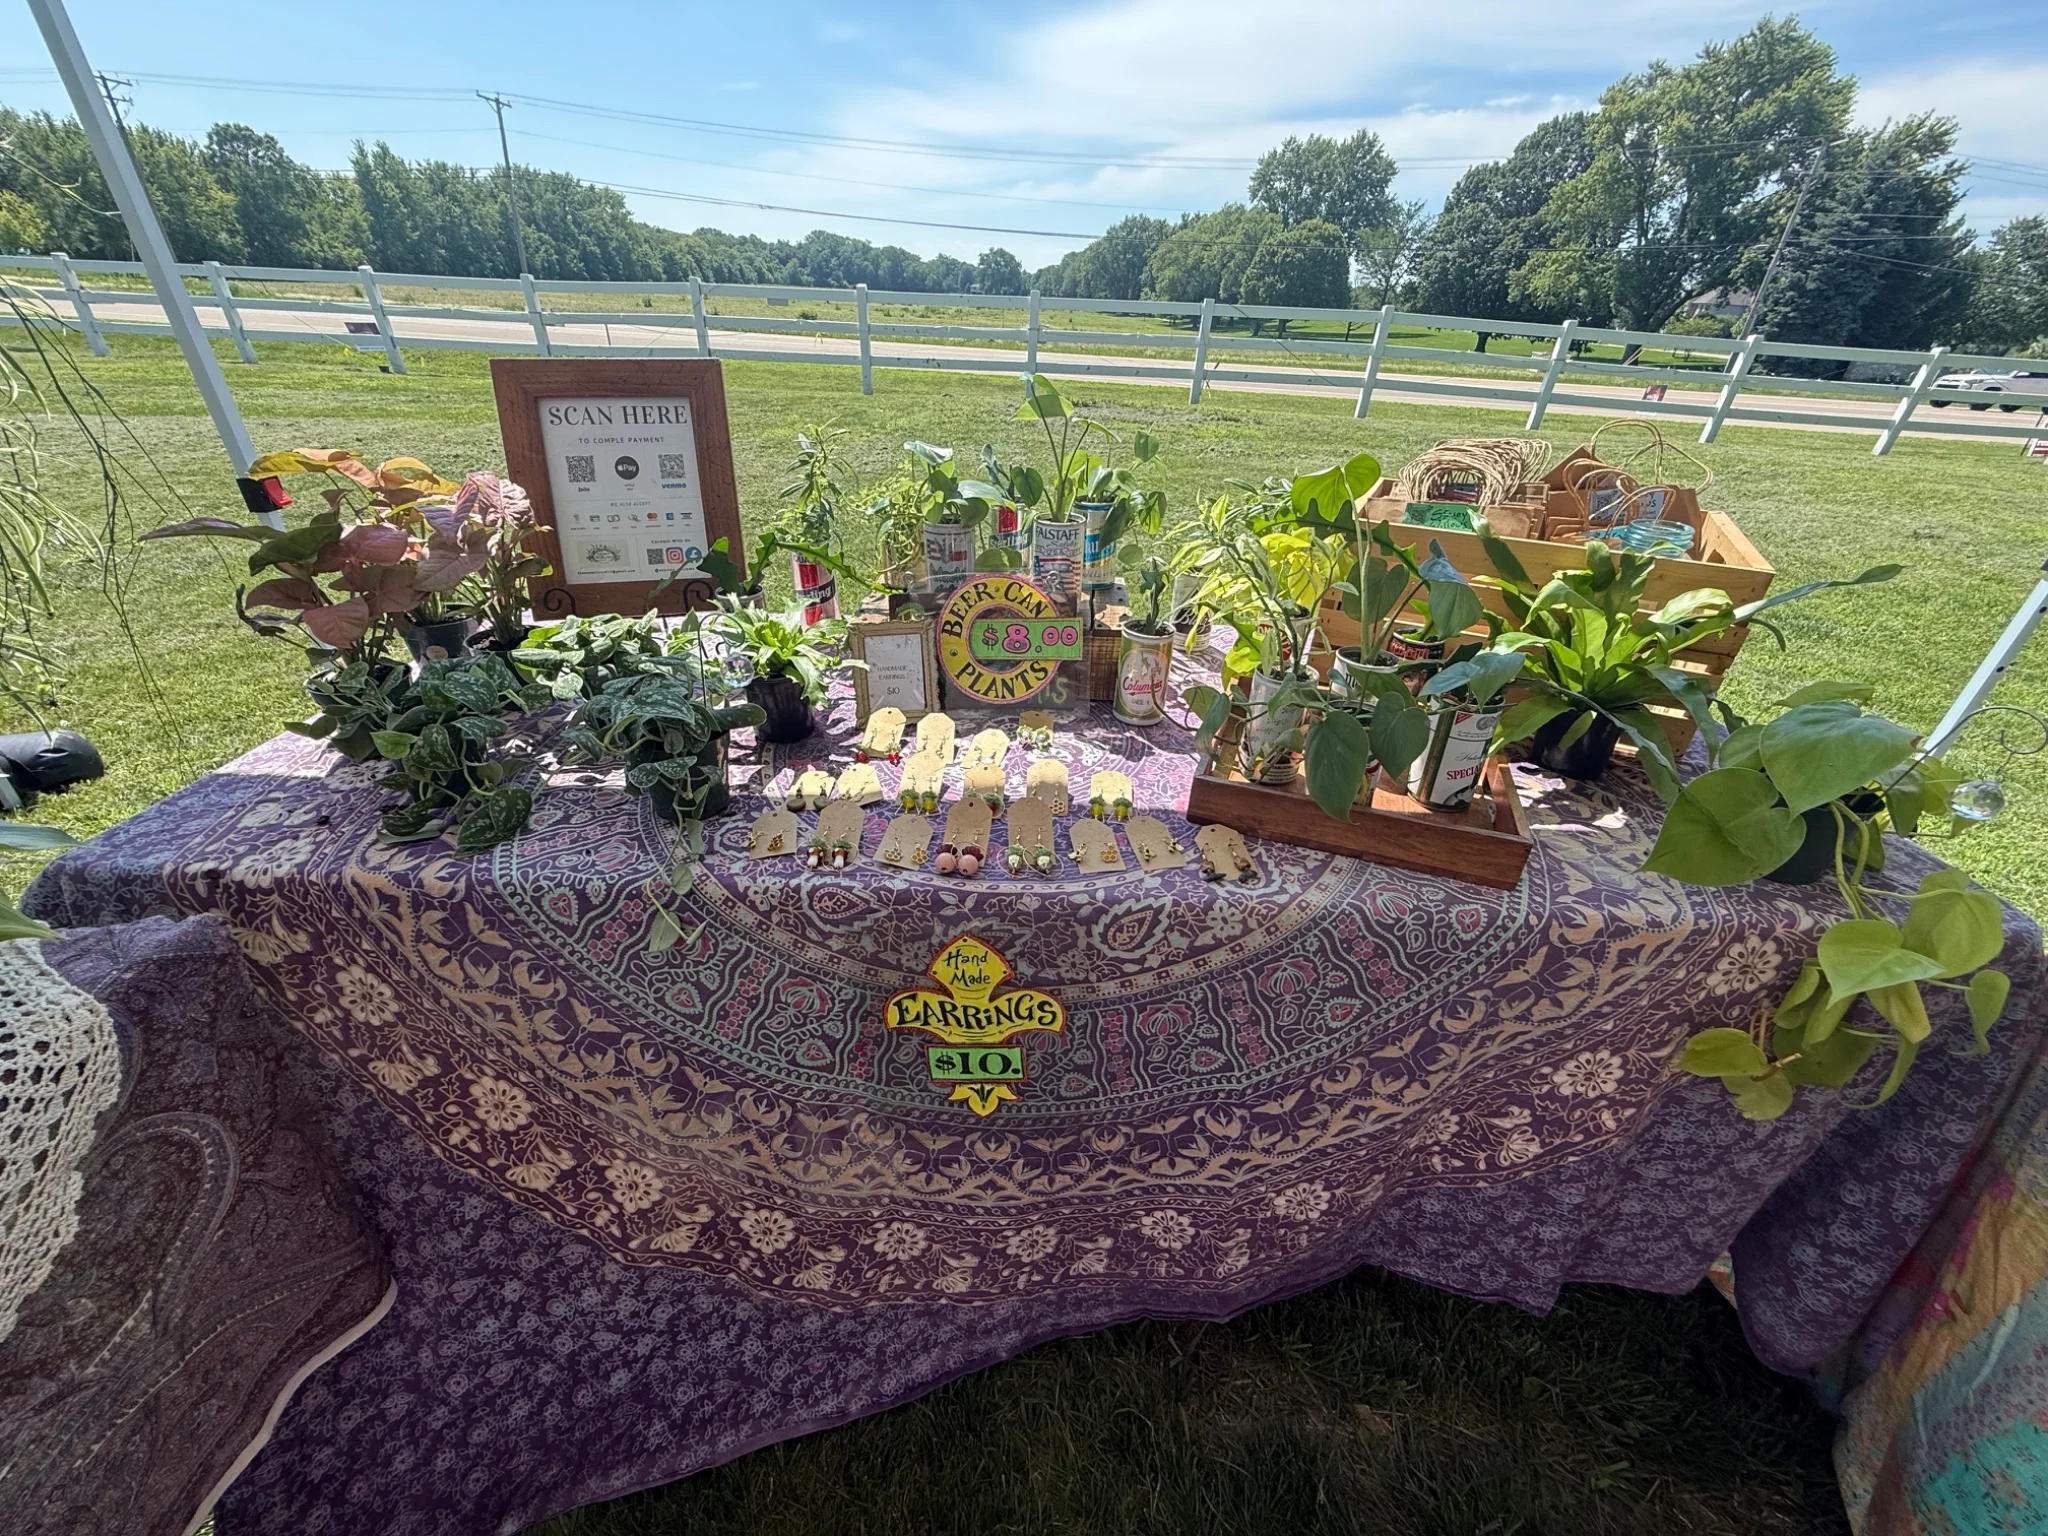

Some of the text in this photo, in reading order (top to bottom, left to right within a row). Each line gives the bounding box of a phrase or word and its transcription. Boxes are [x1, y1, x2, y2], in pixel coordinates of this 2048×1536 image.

[548, 405, 688, 426] SCAN HERE
[623, 464, 637, 473] Pay
[1036, 526, 1080, 541] FALSTAFF
[942, 581, 1049, 639] BEER CAN
[982, 623, 1079, 654] $8.00
[886, 686, 901, 695] $10
[953, 660, 1049, 700] PLANTS
[942, 948, 989, 969] Hand
[949, 969, 991, 988] Made
